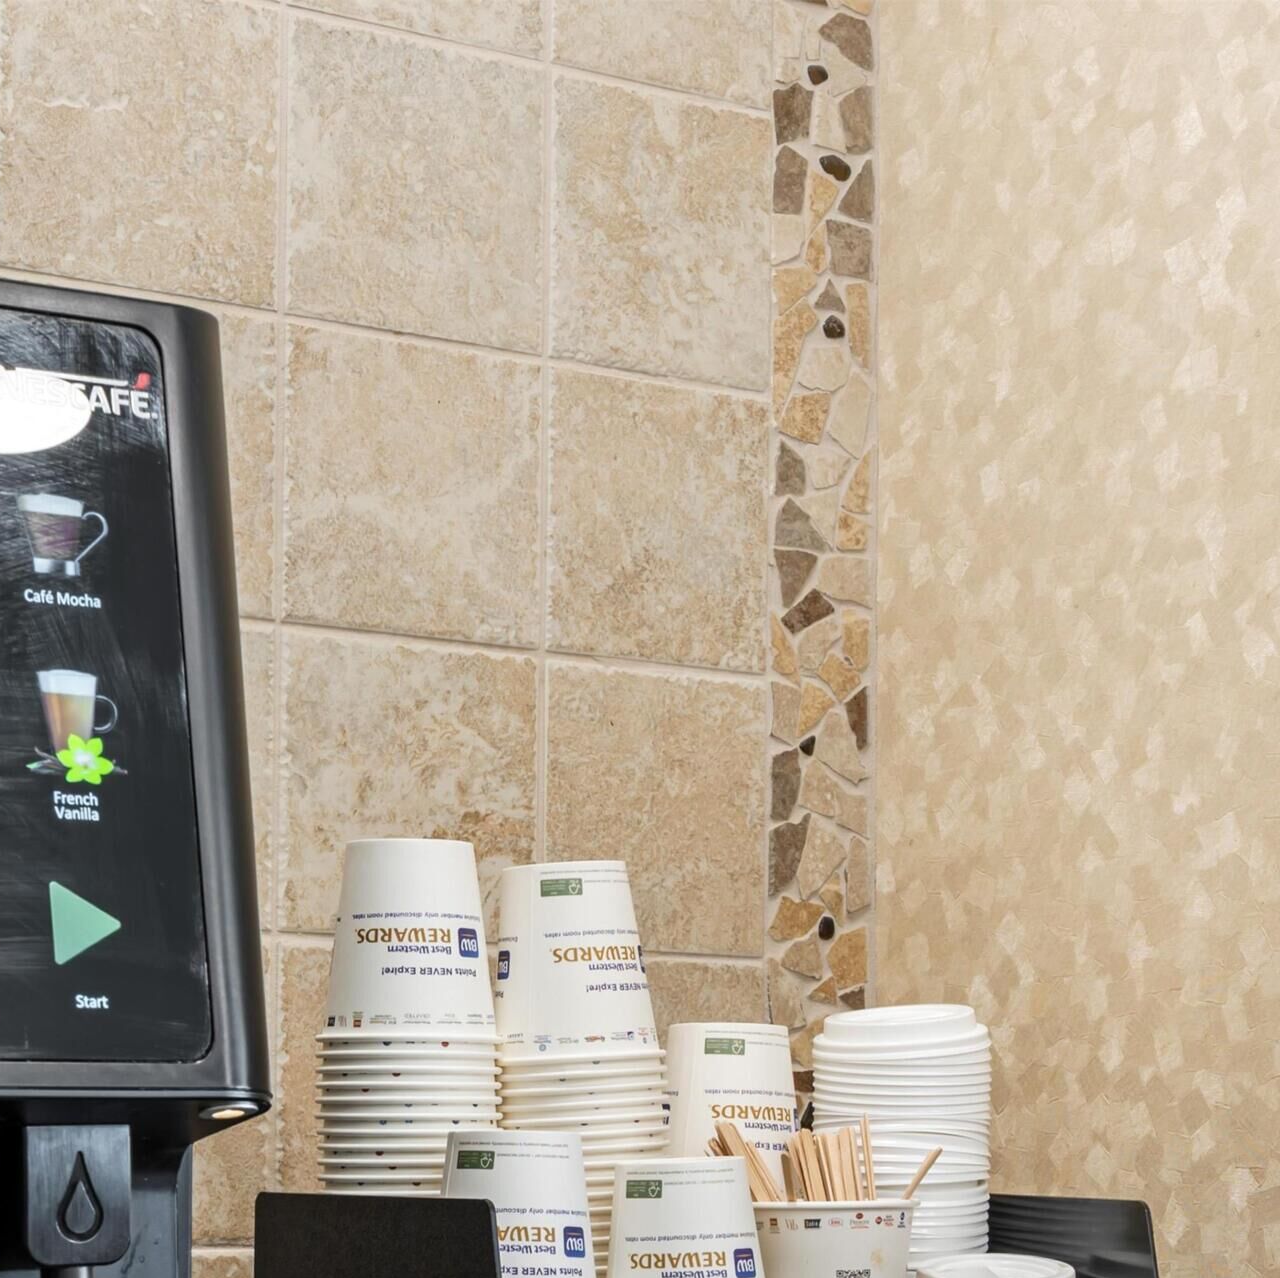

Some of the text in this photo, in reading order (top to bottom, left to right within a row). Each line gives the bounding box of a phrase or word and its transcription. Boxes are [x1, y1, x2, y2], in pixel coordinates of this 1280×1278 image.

[24, 588, 101, 609] Café Mocha
[53, 790, 99, 807] French
[54, 804, 101, 821] Vanilla
[387, 945, 452, 955] Best Western
[460, 939, 477, 952] BW
[381, 965, 477, 977] Points NEVER Expire!
[588, 963, 624, 971] Western
[586, 982, 617, 992] Expire!
[75, 993, 109, 1010] Start
[744, 1122, 779, 1132] Western
[496, 1226, 556, 1242] REWA
[500, 1245, 556, 1255] Best Weste
[566, 1238, 584, 1251] BW
[522, 1267, 583, 1277] Points NEVER
[736, 1259, 754, 1273] BW
[707, 1269, 728, 1278] Best
